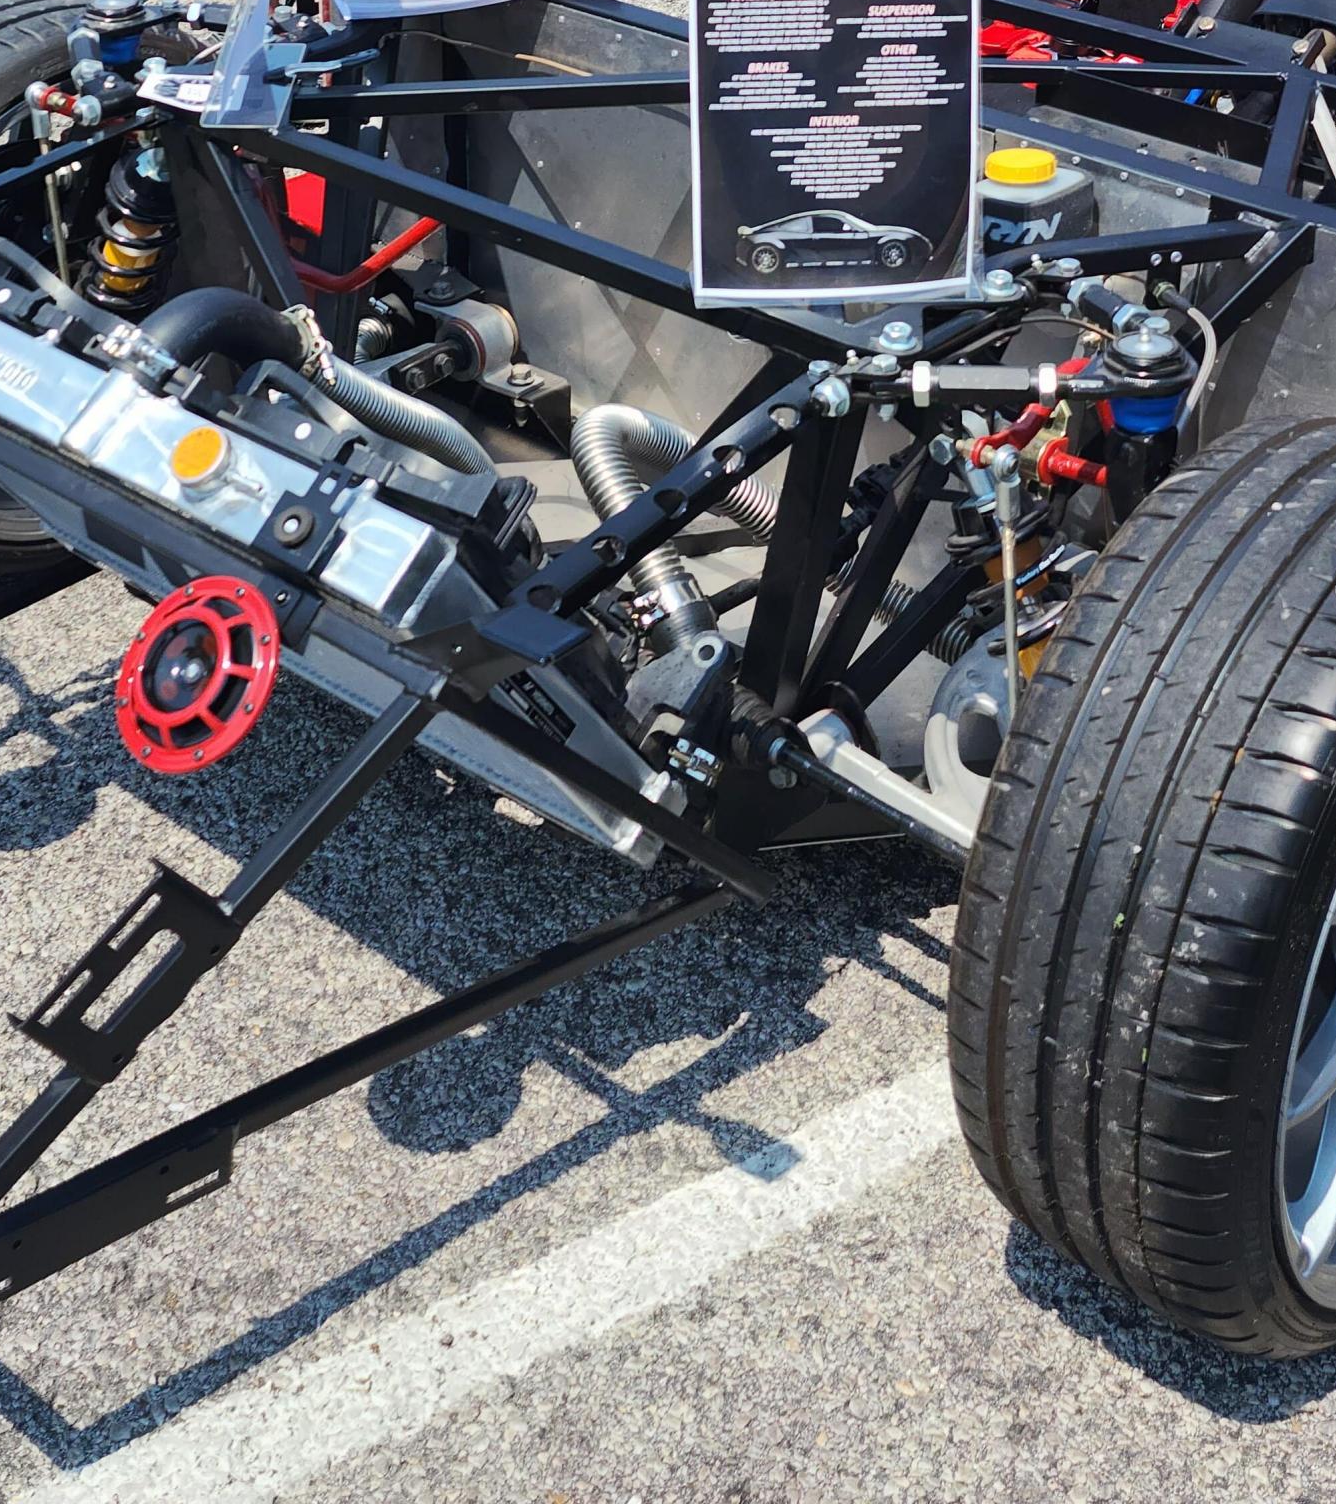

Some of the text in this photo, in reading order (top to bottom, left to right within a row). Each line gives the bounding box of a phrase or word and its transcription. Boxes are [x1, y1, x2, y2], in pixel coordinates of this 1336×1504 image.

[867, 4, 936, 17] SUSPENSION
[880, 43, 918, 56] OTHER
[747, 61, 790, 74] BRAKES
[809, 115, 860, 127] INTERIOR
